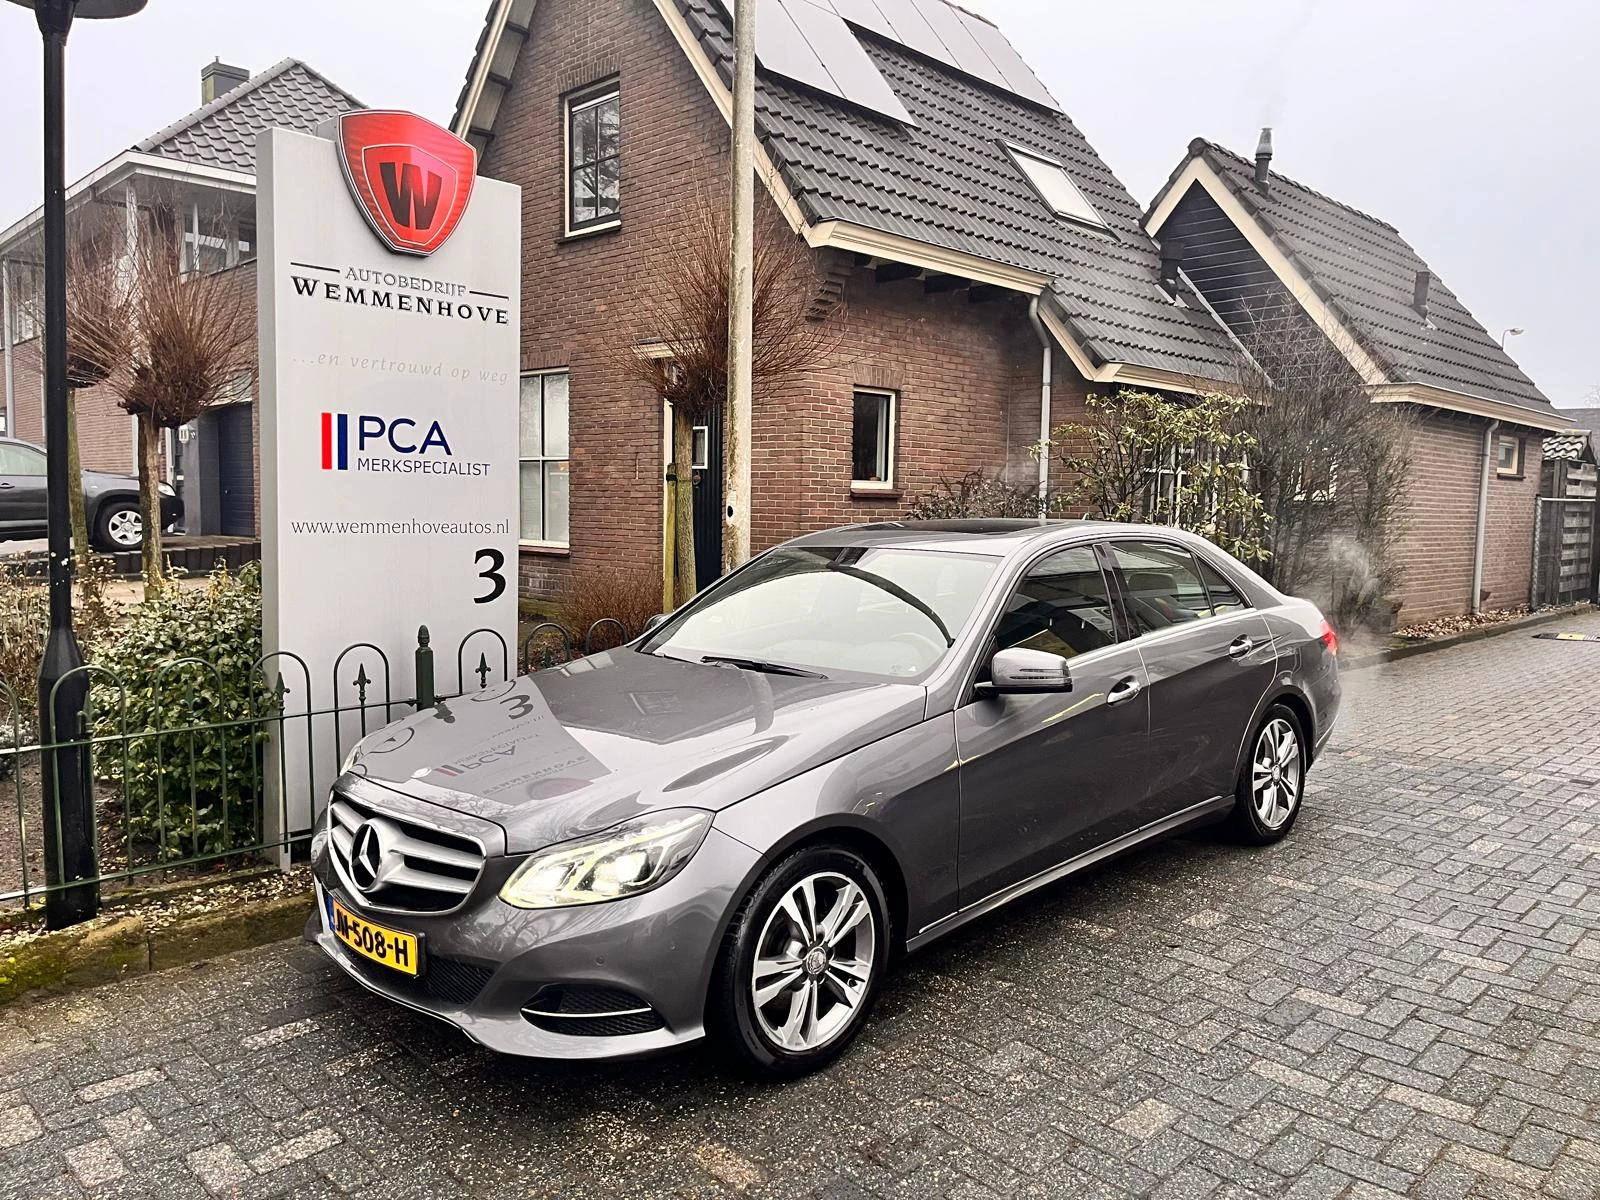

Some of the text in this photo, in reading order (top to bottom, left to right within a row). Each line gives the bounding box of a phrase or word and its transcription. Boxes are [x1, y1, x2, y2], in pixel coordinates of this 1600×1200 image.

[379, 162, 442, 230] W
[345, 266, 466, 297] AUTOBEDRIJF
[290, 275, 509, 325] WEMMENHOVE
[351, 357, 442, 377] vertrouwd
[451, 367, 471, 382] op
[479, 369, 509, 385] weg
[358, 415, 452, 456] PCA
[357, 458, 491, 477] MERKSPECIALIST
[291, 519, 509, 534] www.wemmenhoveautos.nl
[473, 548, 507, 604] 3
